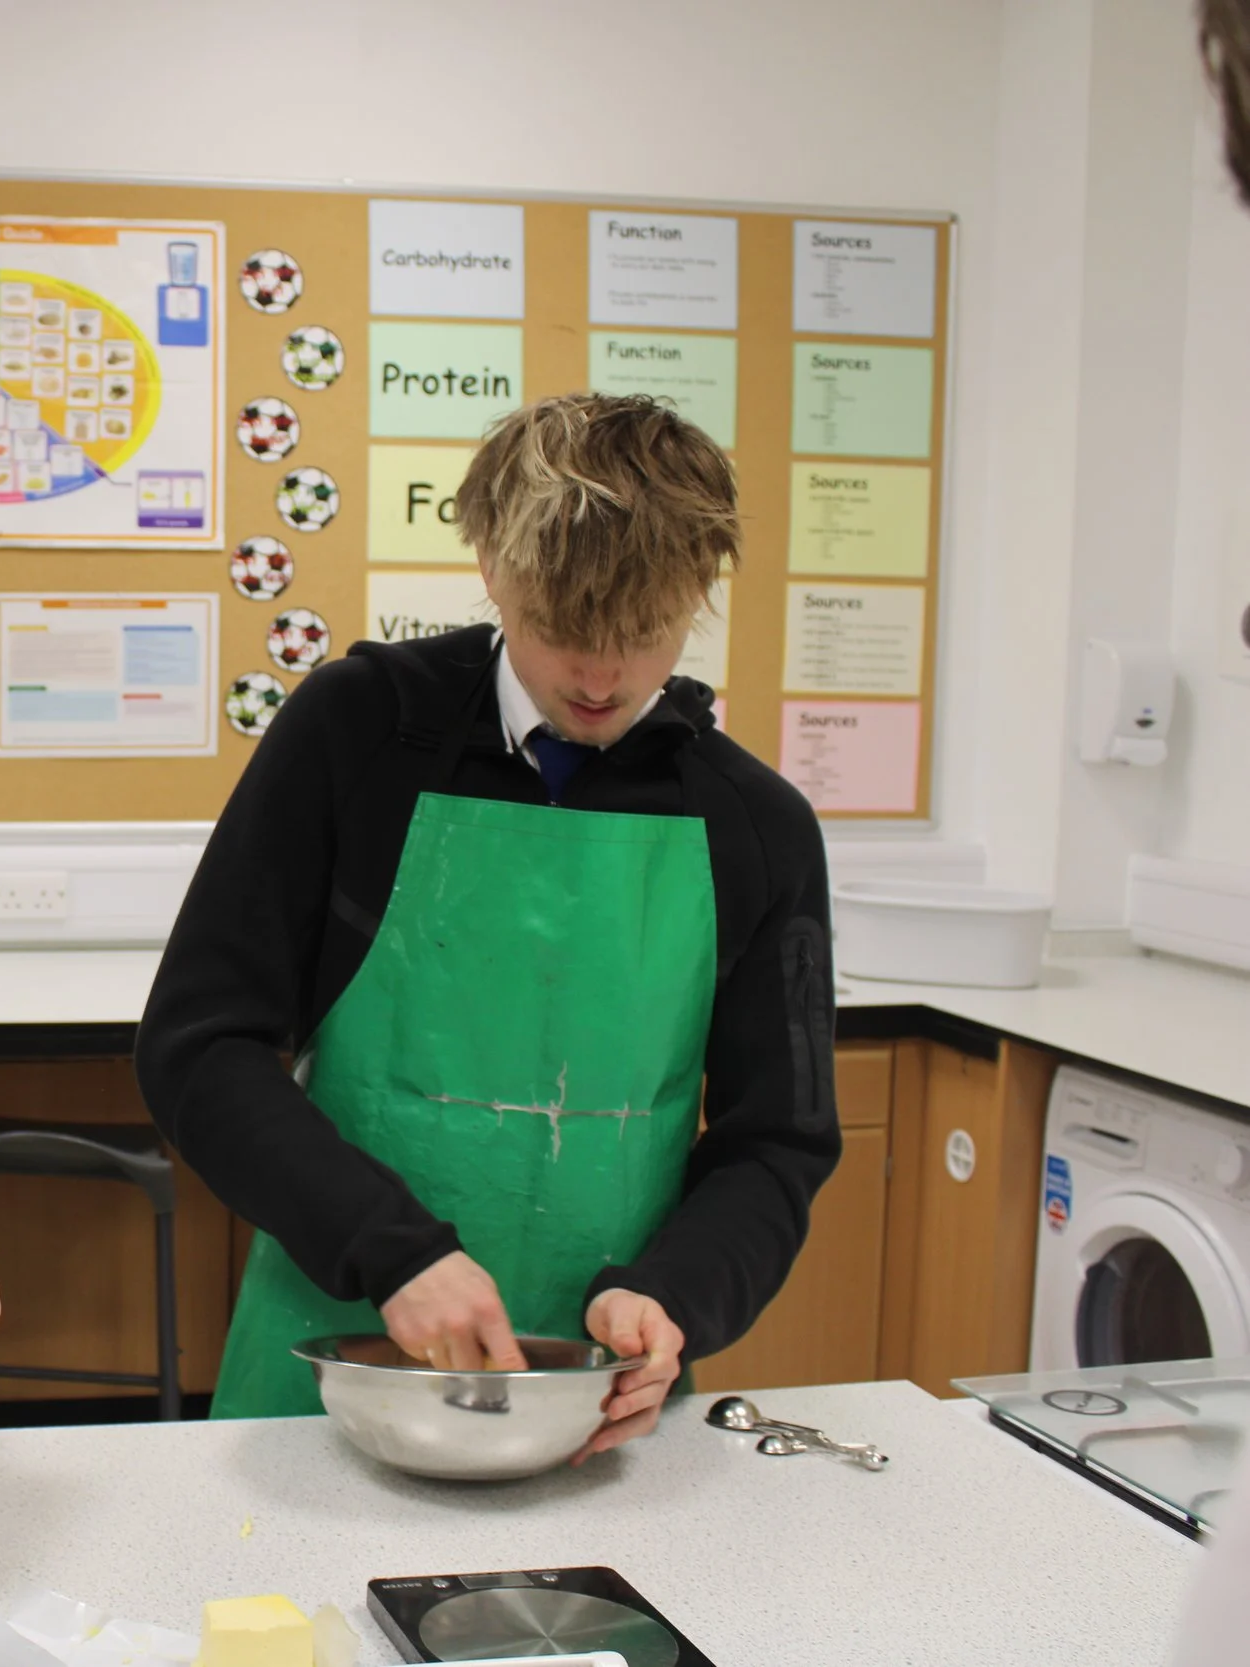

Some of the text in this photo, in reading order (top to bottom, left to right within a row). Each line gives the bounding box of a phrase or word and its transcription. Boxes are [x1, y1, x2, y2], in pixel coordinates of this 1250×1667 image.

[607, 220, 683, 241] Function
[811, 231, 872, 250] Sources
[382, 249, 511, 273] Carbohydrate
[607, 340, 682, 361] Function
[811, 352, 872, 372] Sources
[382, 361, 511, 398] Protein
[809, 473, 868, 491] Sources
[803, 592, 863, 611] Sources
[799, 711, 858, 729] Sources
